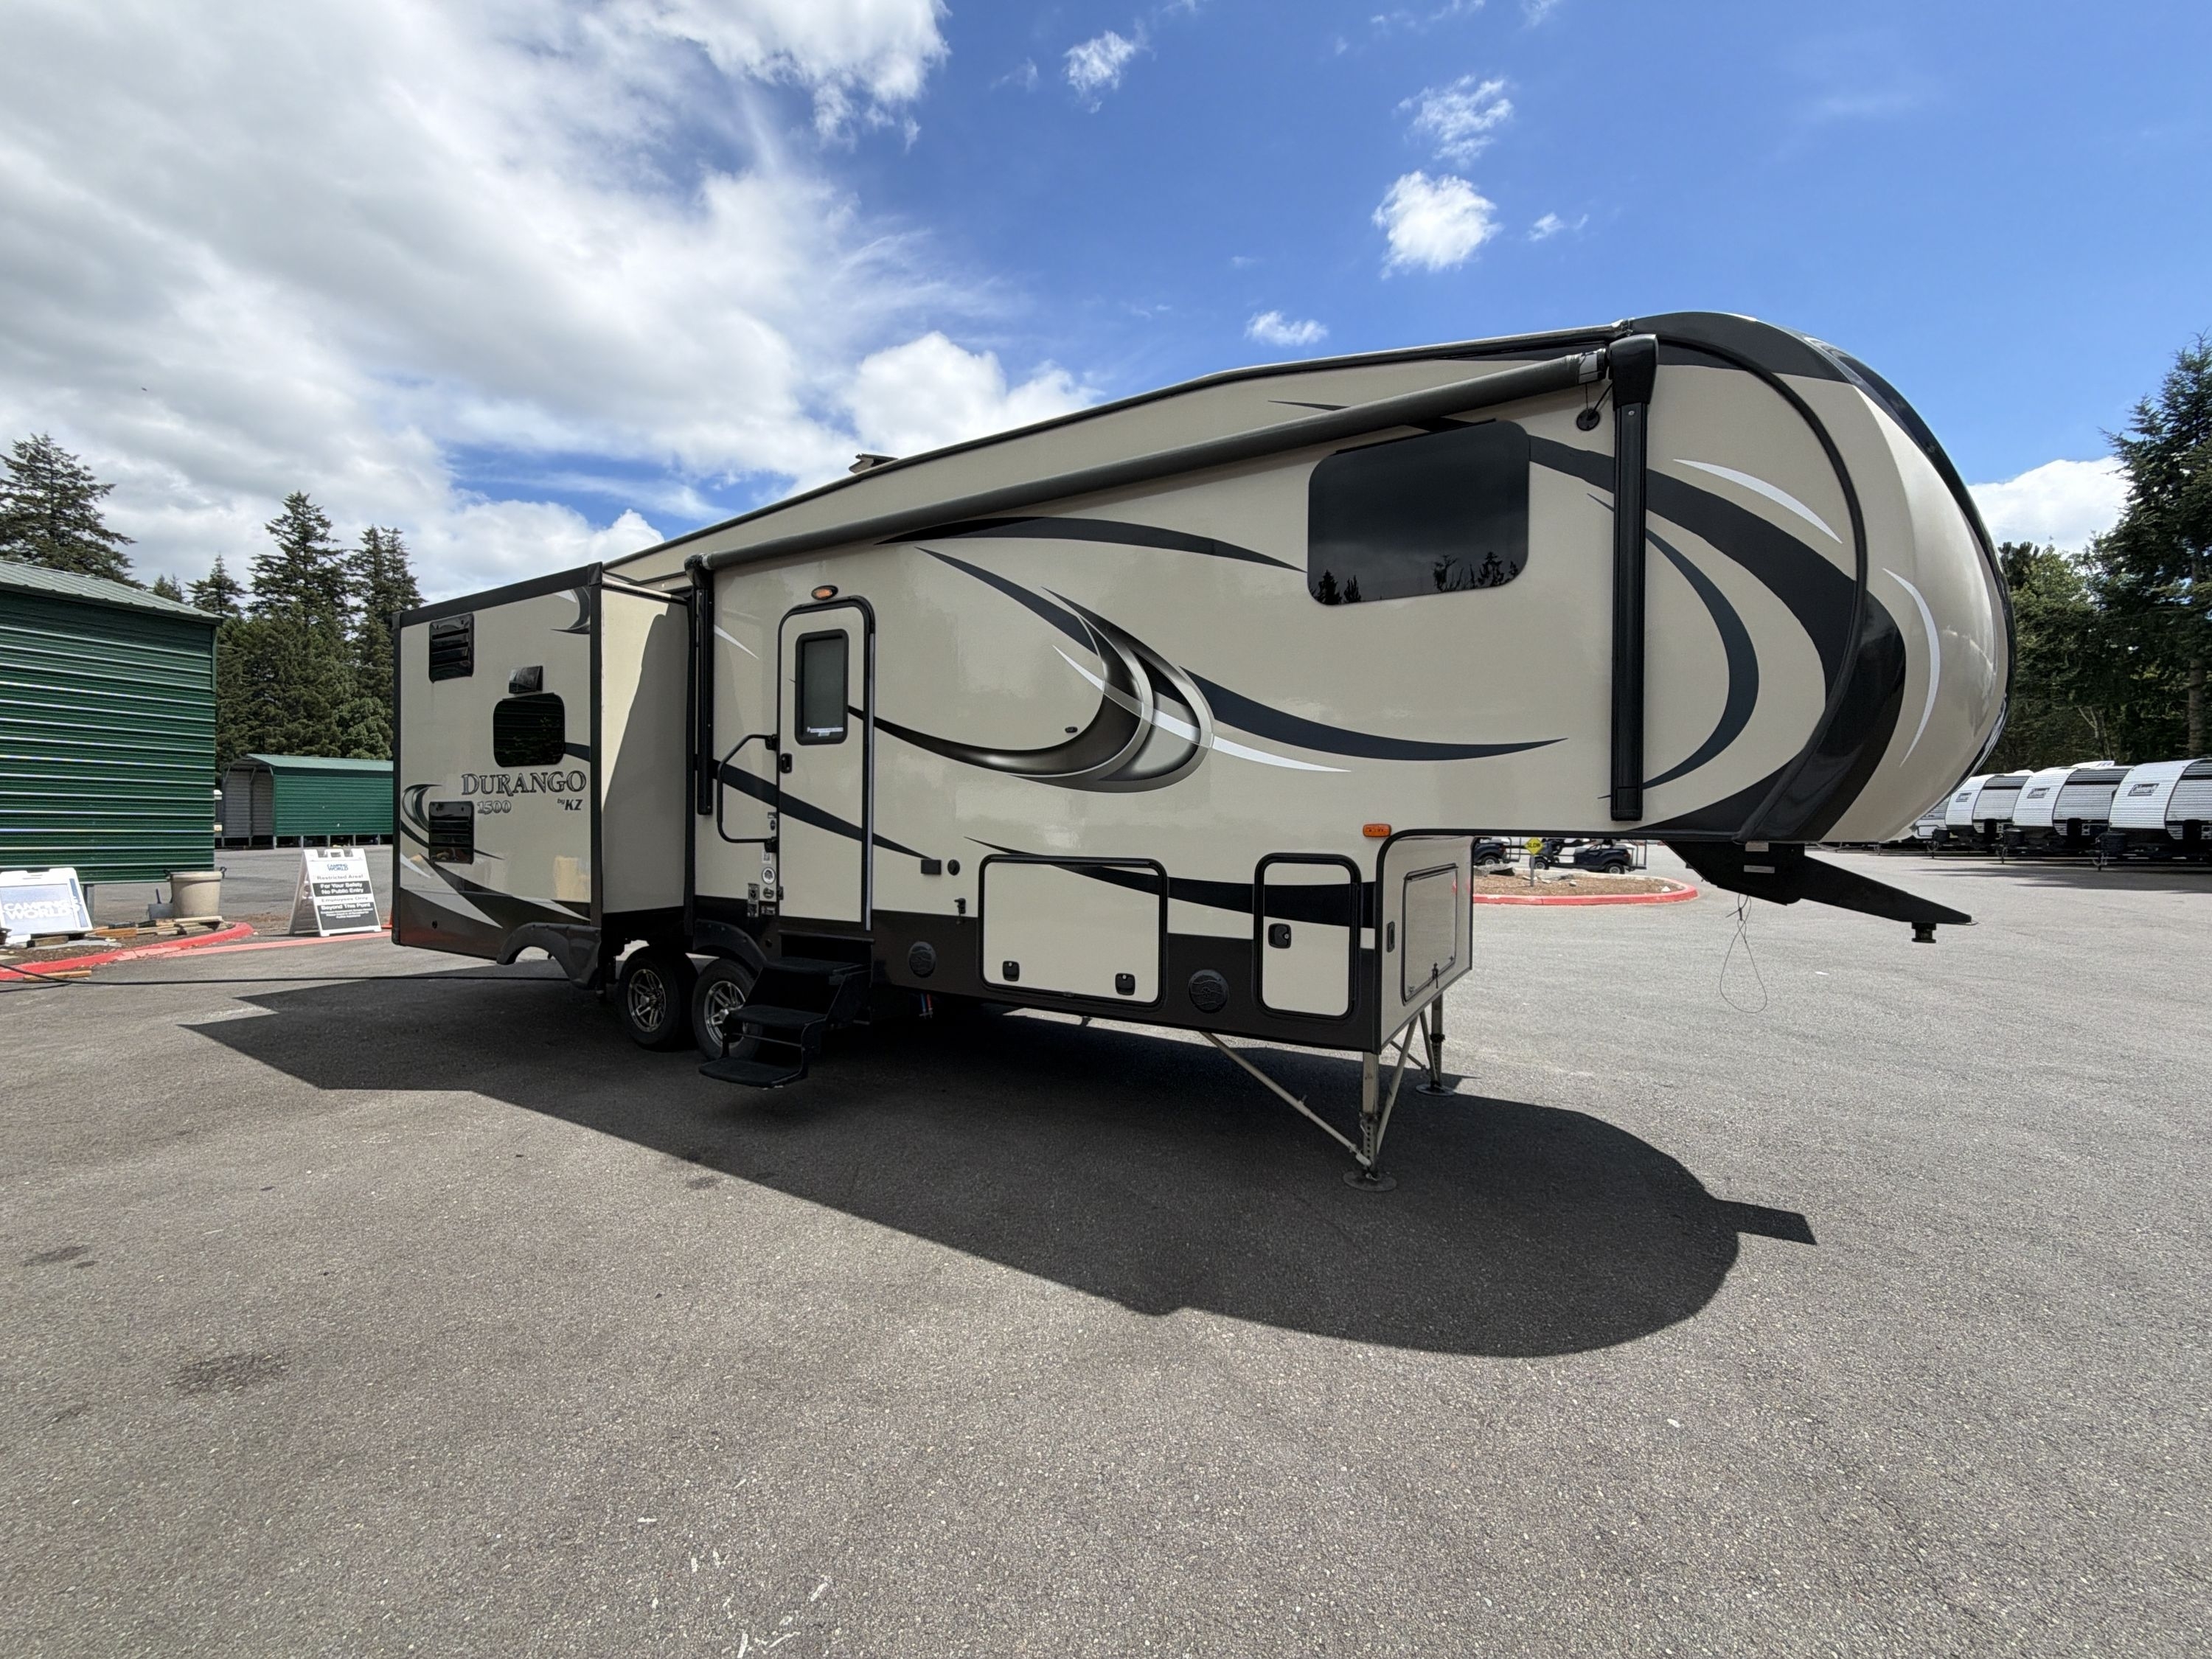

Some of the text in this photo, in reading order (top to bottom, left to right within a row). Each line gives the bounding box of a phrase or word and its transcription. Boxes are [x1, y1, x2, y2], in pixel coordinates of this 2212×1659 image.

[462, 770, 587, 797] DURANGO
[477, 800, 512, 815] 1500
[565, 799, 583, 810] KZ
[5, 908, 71, 920] WORLD
